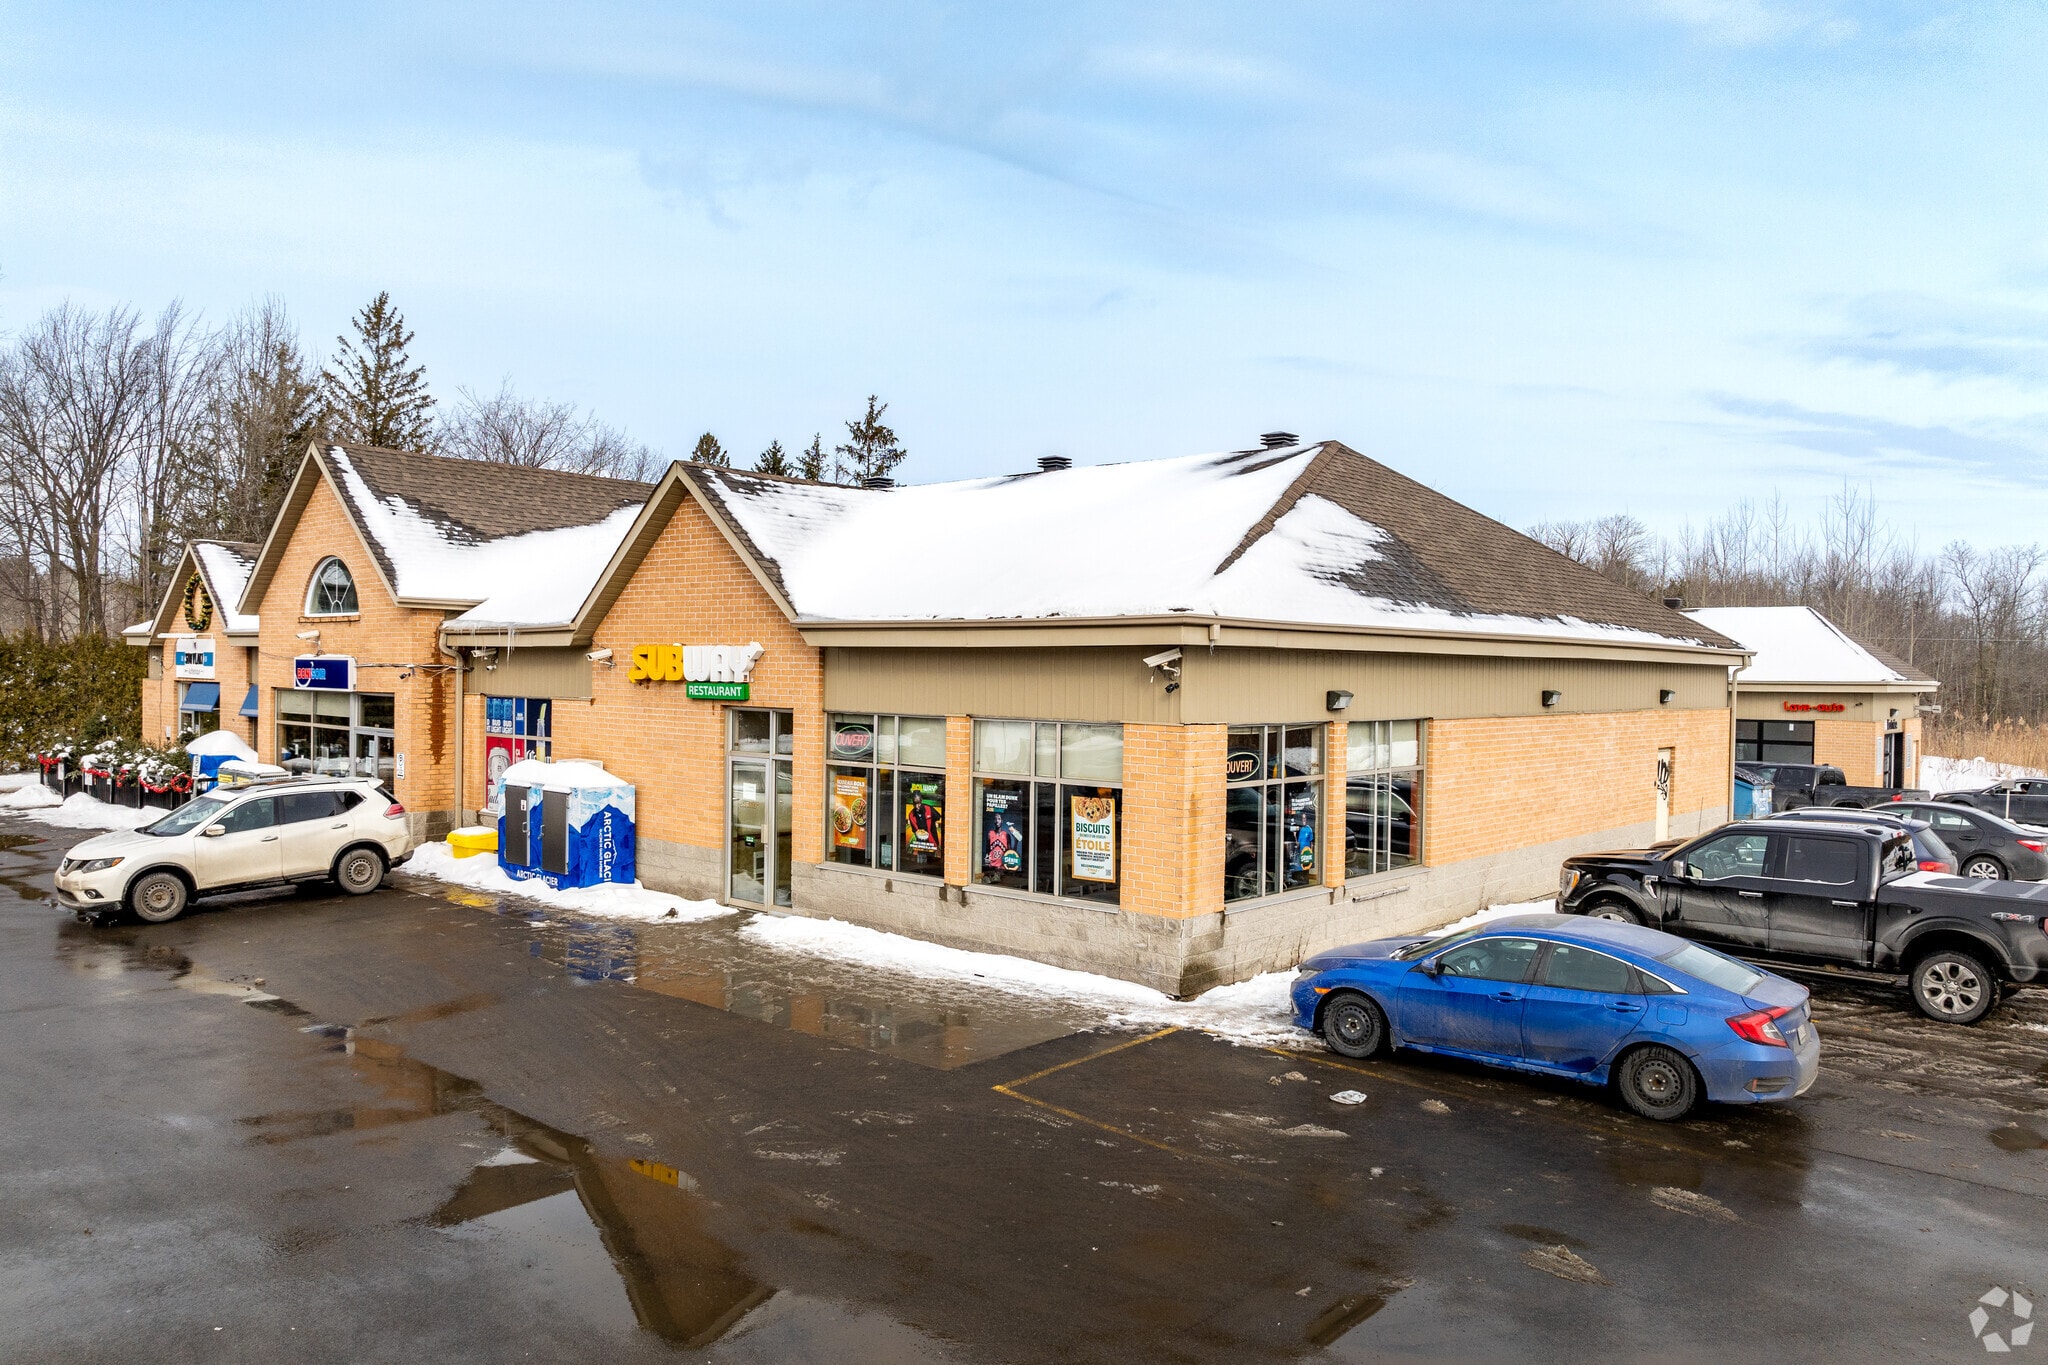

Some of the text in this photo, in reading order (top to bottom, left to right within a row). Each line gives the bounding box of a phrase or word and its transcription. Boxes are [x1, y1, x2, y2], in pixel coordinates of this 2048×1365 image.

[628, 642, 765, 684] SUBWAY
[688, 685, 742, 697] RESTAURANT
[836, 734, 869, 746] OUVERT
[1227, 760, 1254, 774] OUVERT
[1075, 822, 1111, 835] BISCUITS
[603, 811, 612, 882] ARCTIC GLACI
[1075, 837, 1111, 852] ÉTOILE
[516, 869, 536, 880] ARCTIC
